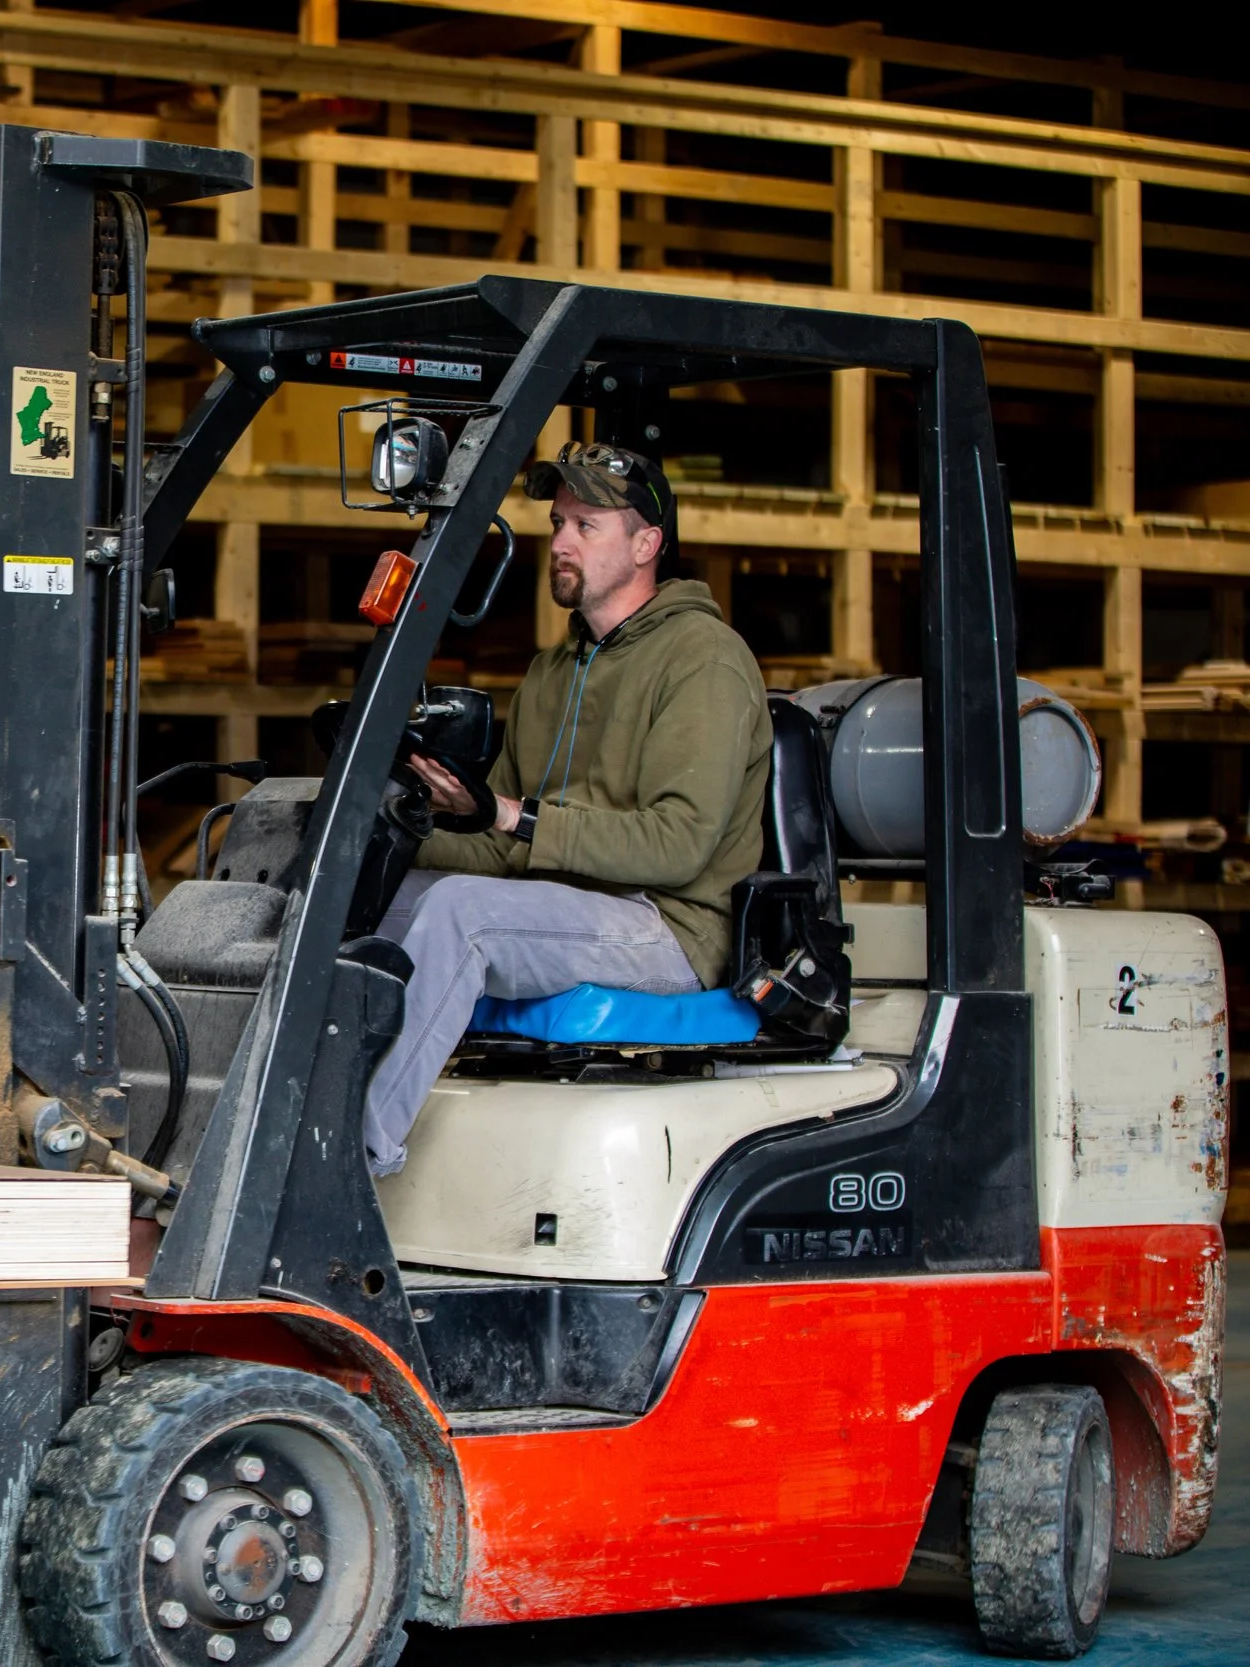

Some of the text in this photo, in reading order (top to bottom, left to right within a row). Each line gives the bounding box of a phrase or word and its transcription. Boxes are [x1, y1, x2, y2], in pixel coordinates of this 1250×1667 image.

[1118, 965, 1136, 1016] 2
[829, 1172, 906, 1213] 80
[763, 1226, 905, 1263] NISSAN
